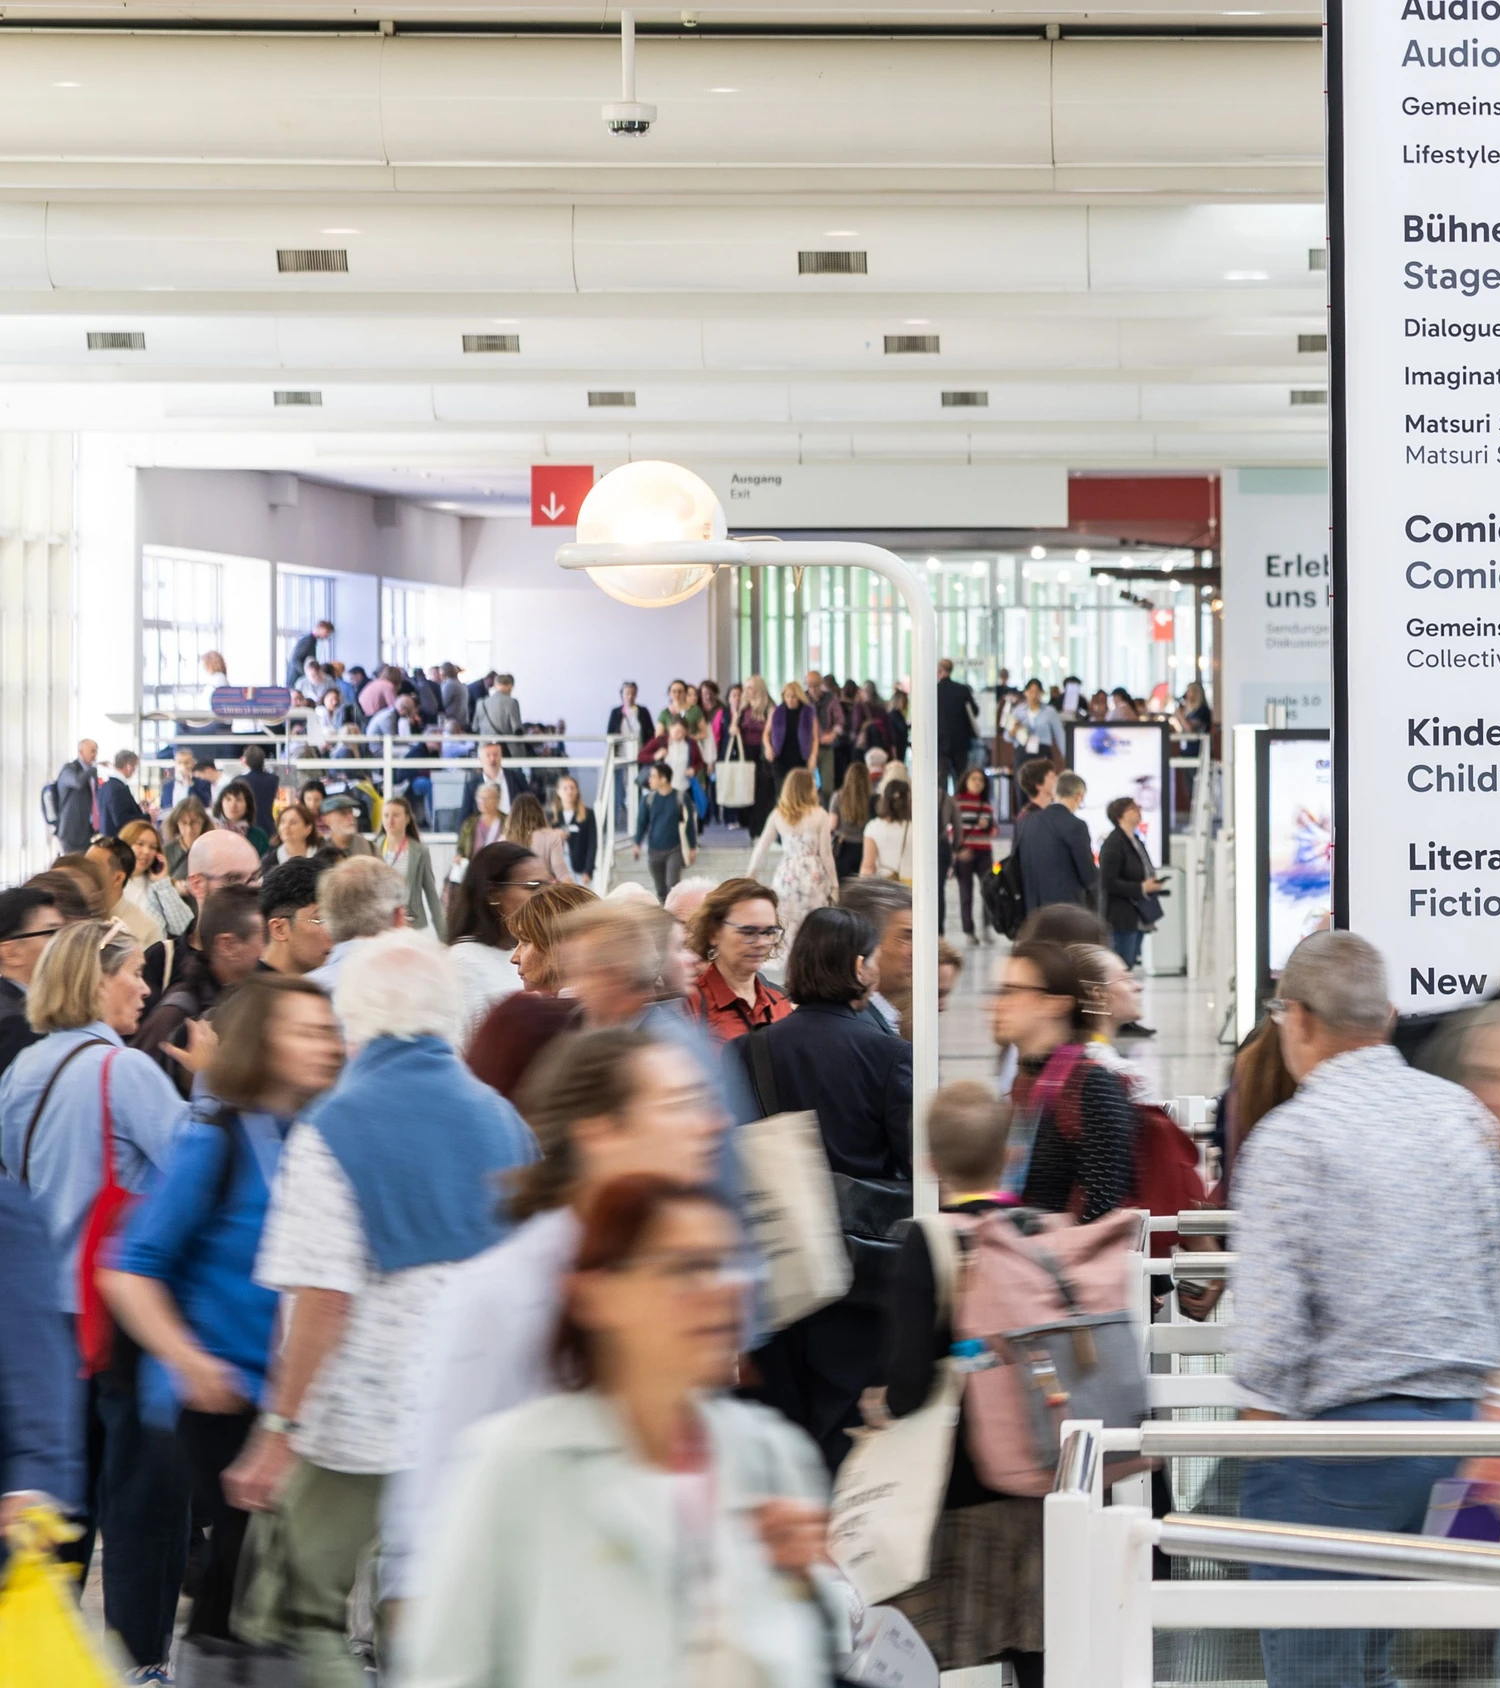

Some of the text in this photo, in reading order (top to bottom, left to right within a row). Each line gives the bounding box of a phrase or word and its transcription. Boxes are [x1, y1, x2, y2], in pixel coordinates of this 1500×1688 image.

[1403, 143, 1500, 169] Lifestyle
[1405, 413, 1491, 434] Matsuri
[1406, 444, 1488, 465] Matsuri
[731, 473, 782, 486] Ausgang
[730, 488, 751, 499] Exit
[1266, 590, 1317, 608] uns
[1409, 967, 1488, 996] New
